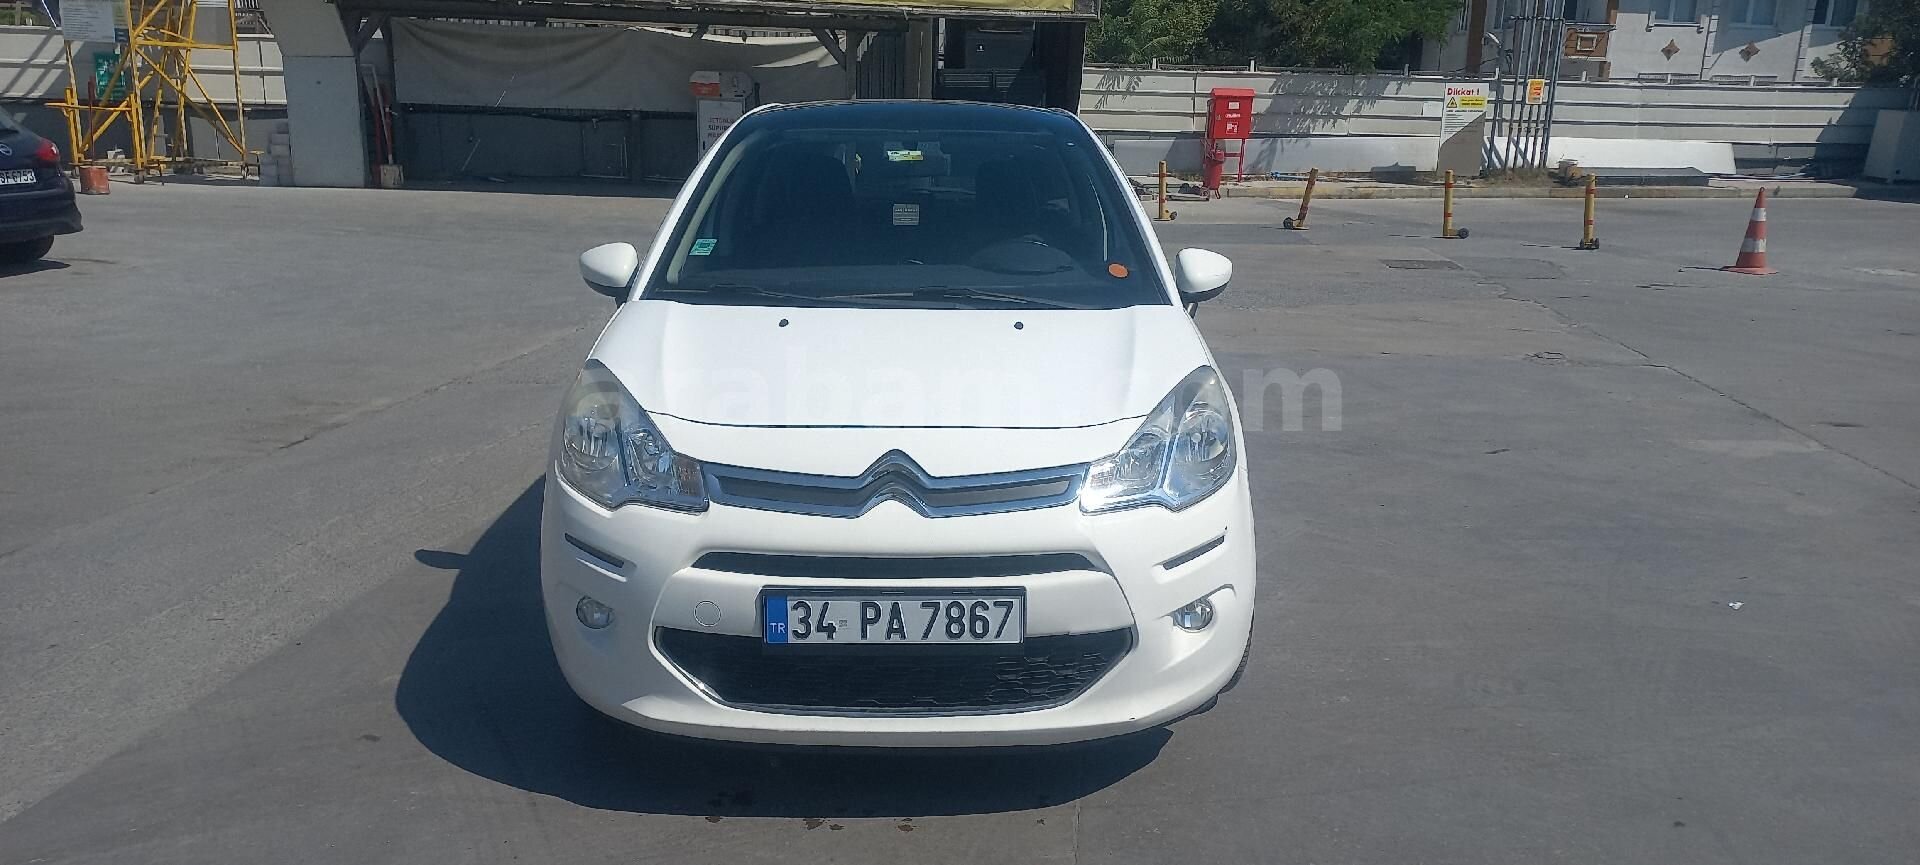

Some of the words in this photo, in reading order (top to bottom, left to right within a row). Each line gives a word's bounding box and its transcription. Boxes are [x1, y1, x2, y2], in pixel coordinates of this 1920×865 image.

[1447, 87, 1474, 96] Dikkat
[791, 600, 837, 641] 34
[861, 601, 907, 641] PA
[920, 600, 1014, 641] 7867
[769, 622, 786, 634] TR
